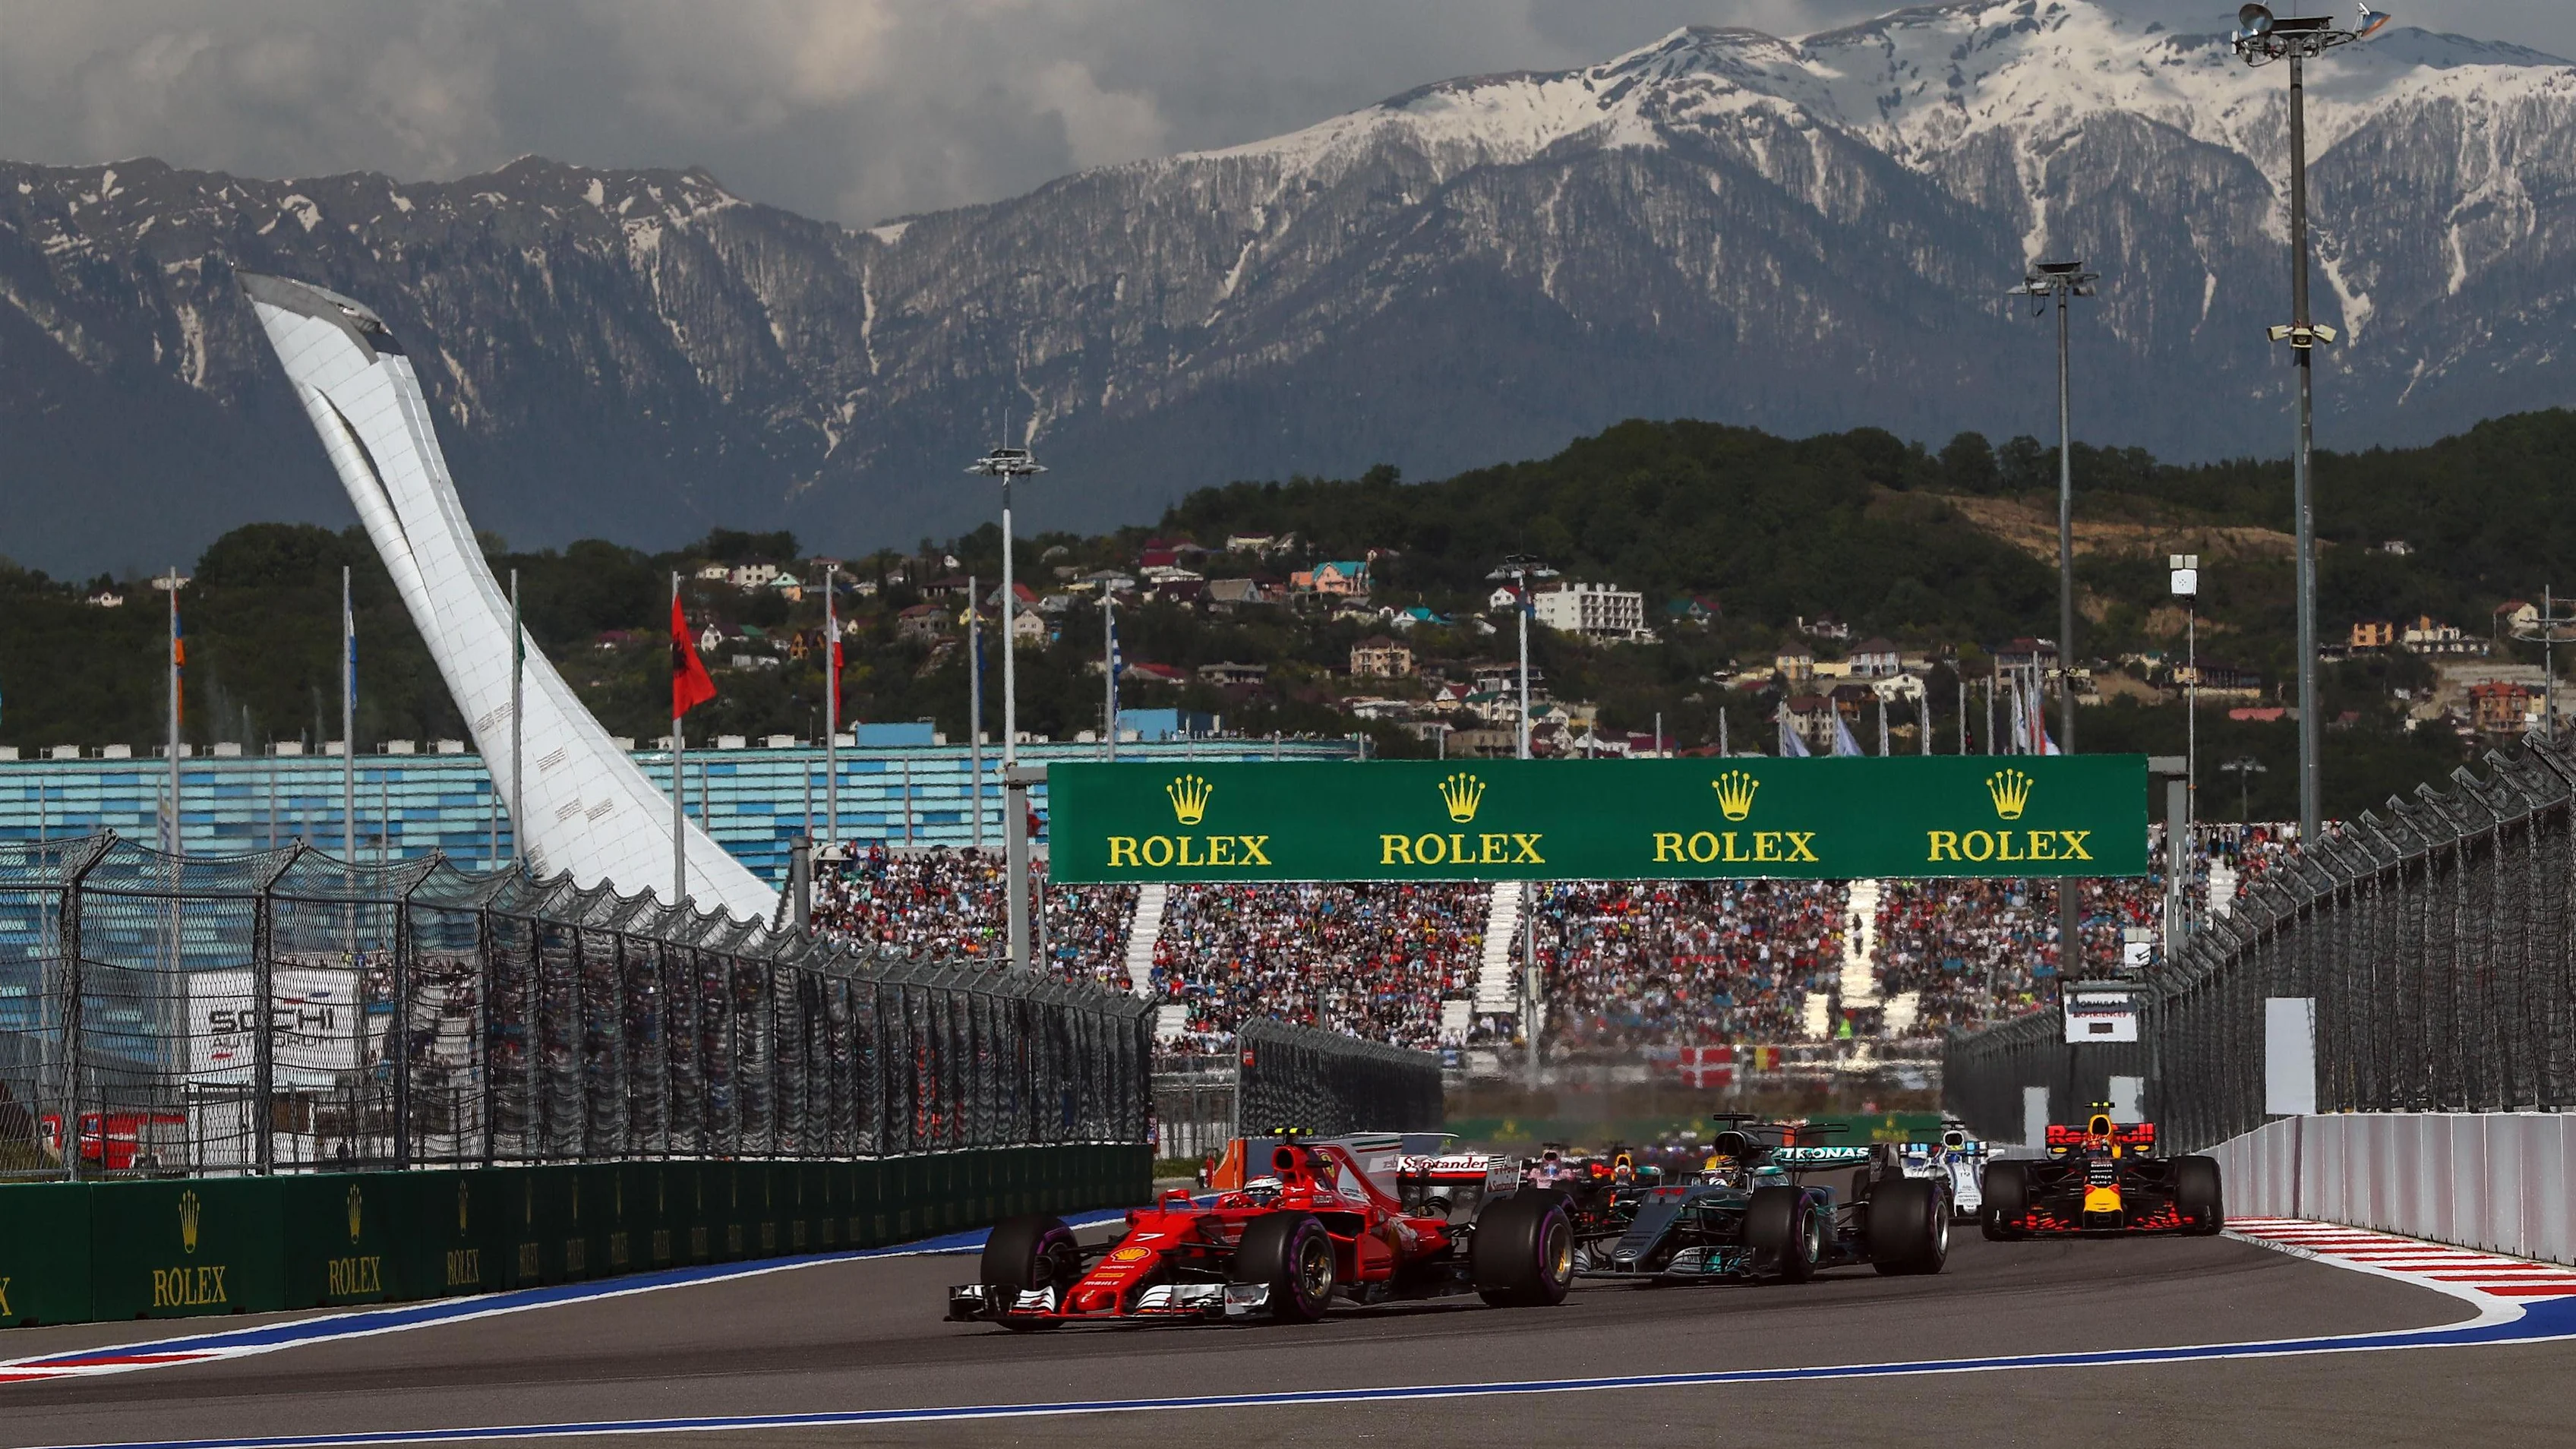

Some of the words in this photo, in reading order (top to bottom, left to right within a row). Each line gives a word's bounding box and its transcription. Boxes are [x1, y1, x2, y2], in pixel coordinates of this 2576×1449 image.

[1107, 835, 1272, 867] ROLEX
[1381, 833, 1545, 864] ROLEX
[1653, 831, 1819, 863] ROLEX
[1927, 830, 2093, 862] ROLEX
[1134, 1233, 1165, 1242] 7
[329, 1256, 381, 1296] ROLEX
[447, 1249, 480, 1286] ROLEX
[153, 1265, 228, 1308] ROLEX
